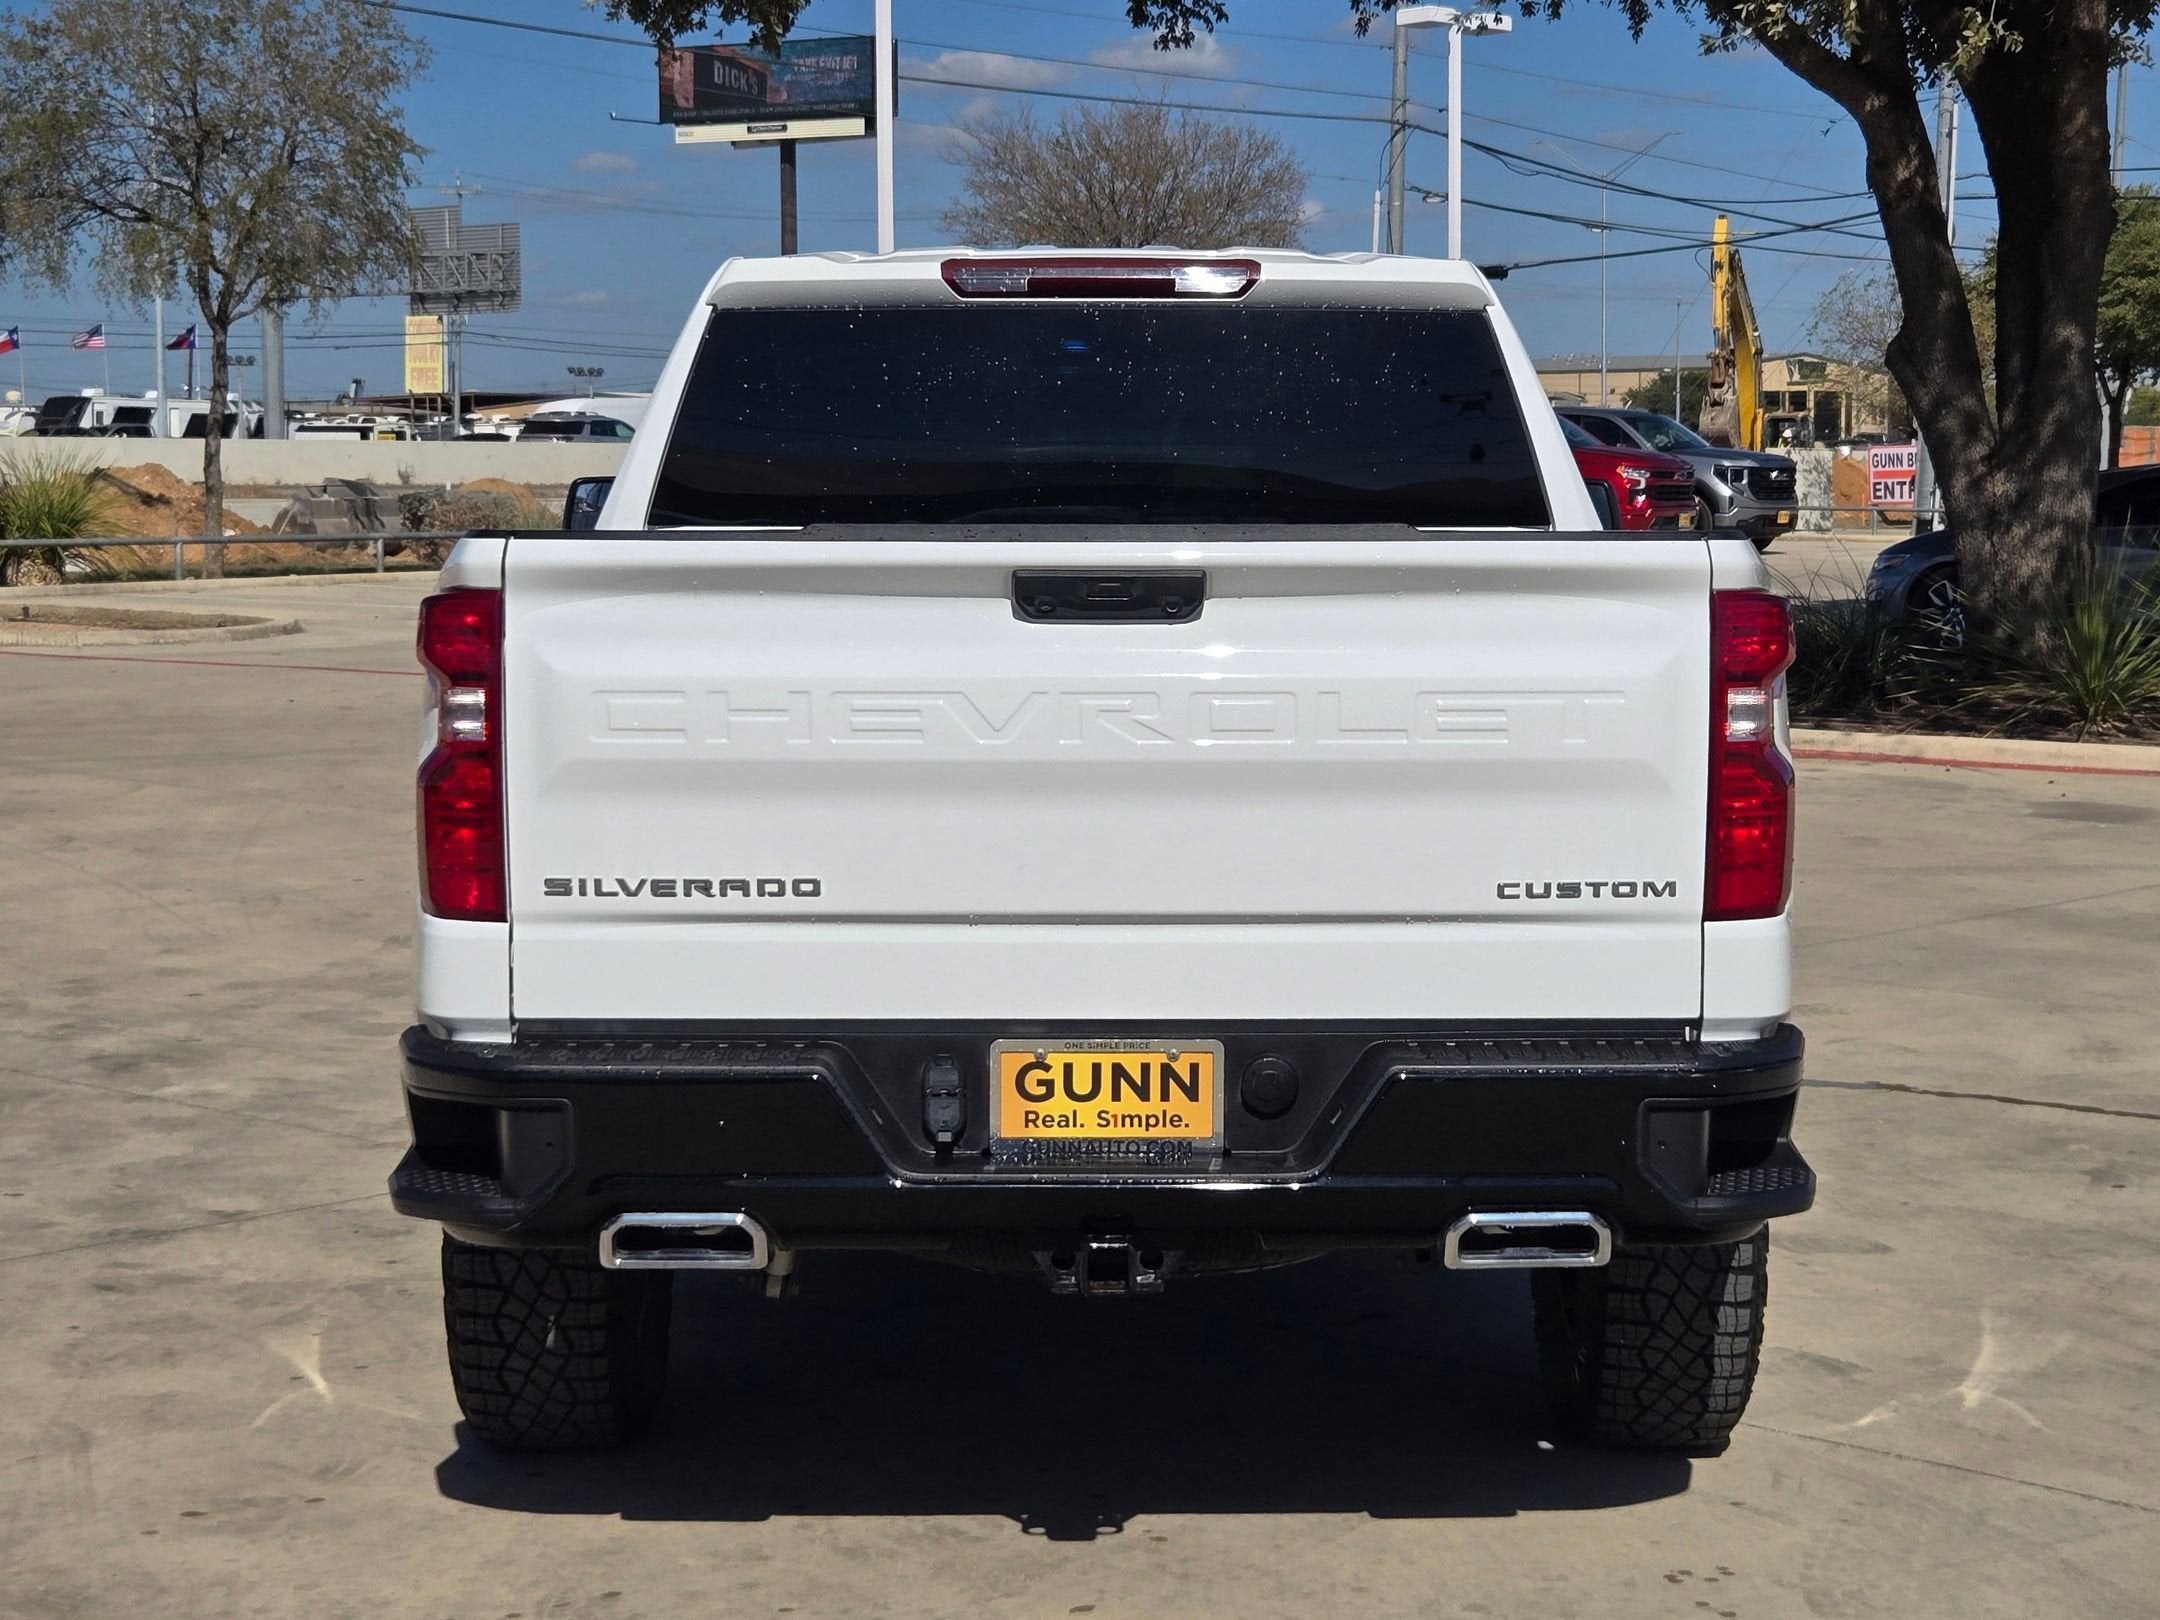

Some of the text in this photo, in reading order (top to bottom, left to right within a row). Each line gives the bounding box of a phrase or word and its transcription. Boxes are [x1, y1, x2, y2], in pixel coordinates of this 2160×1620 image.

[714, 60, 758, 96] DICK'S
[1872, 453, 1903, 469] GUNN
[590, 690, 1626, 744] CHEVROLET
[543, 877, 822, 898] SILVERADO
[1496, 880, 1677, 900] CUSTOM
[1064, 1042, 1085, 1050] ONE
[1014, 1061, 1200, 1103] GUNN
[1024, 1109, 1085, 1129] Real.
